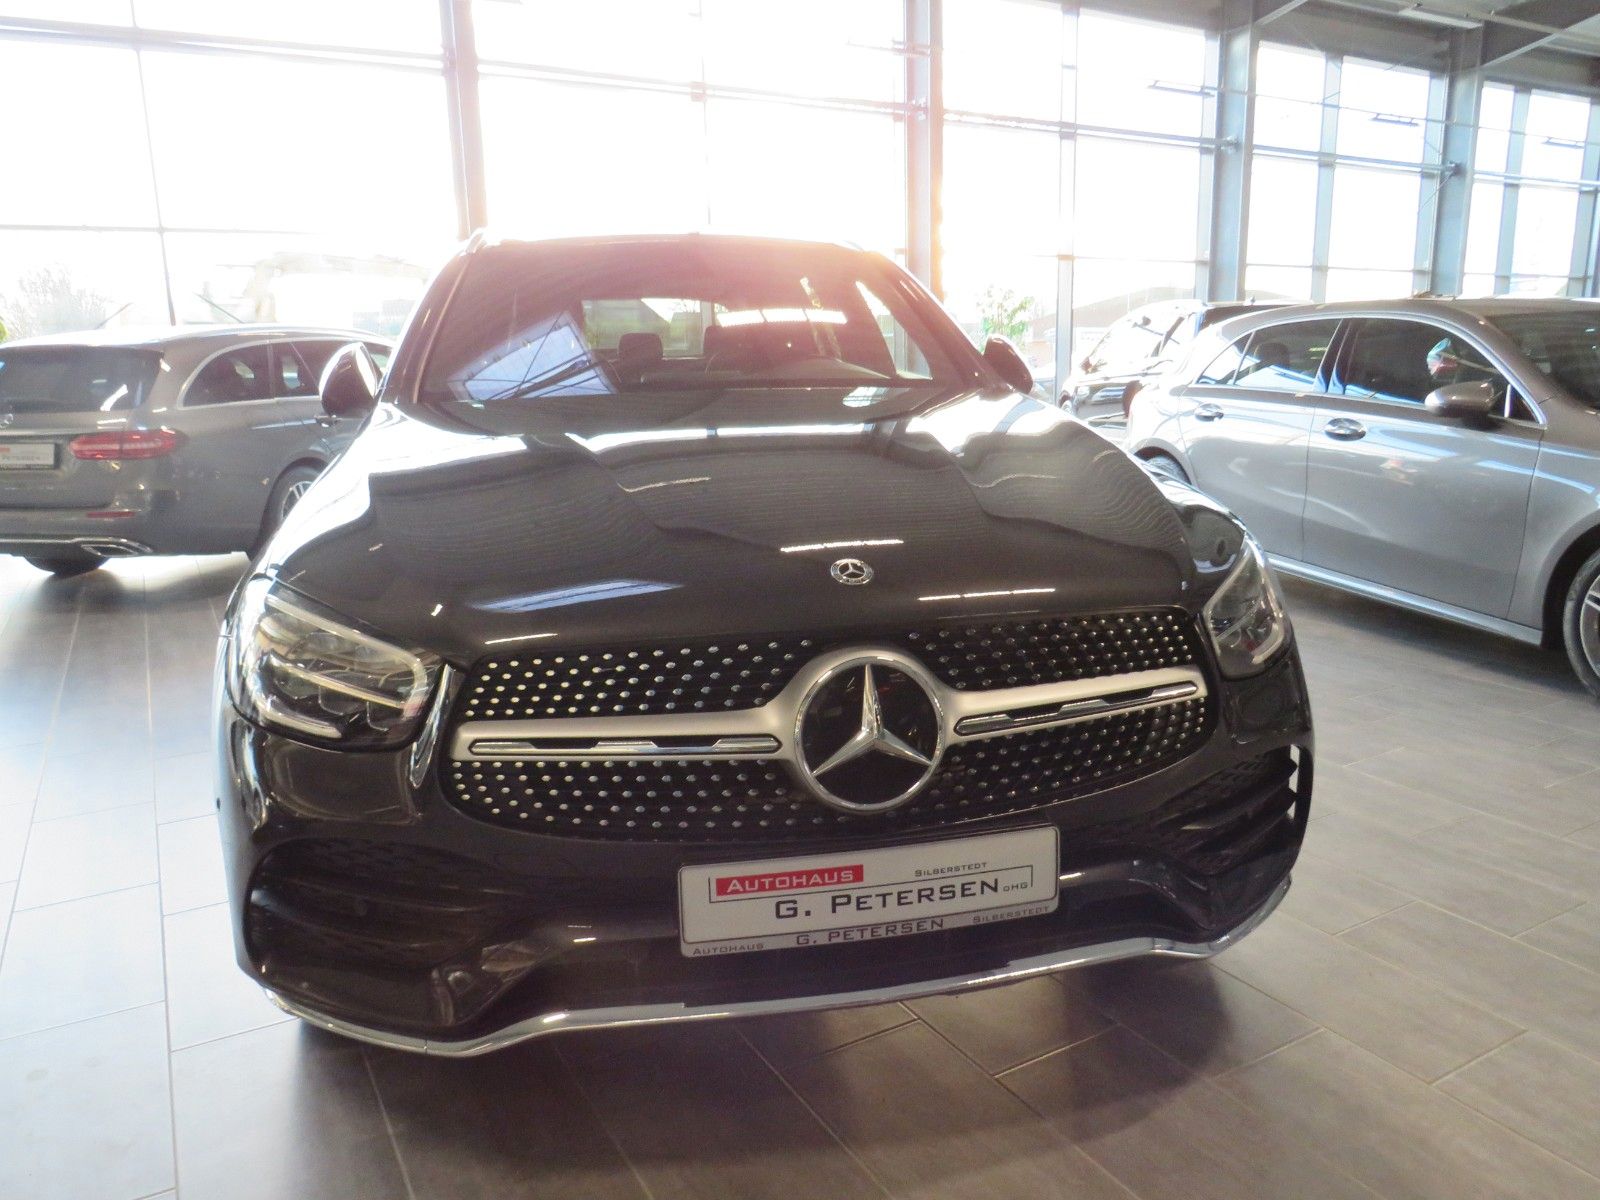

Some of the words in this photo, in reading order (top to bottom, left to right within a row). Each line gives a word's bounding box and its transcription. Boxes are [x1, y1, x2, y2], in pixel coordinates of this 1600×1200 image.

[727, 871, 853, 893] AUTOHAUS
[914, 862, 987, 877] SILBERSTEDT
[775, 899, 811, 919] G.
[831, 878, 999, 914] PETERSEN
[693, 942, 764, 955] AUTOHAUS
[796, 933, 817, 945] G.
[828, 918, 944, 942] PETERSEN
[973, 906, 1049, 923] SILBERSTEDT
